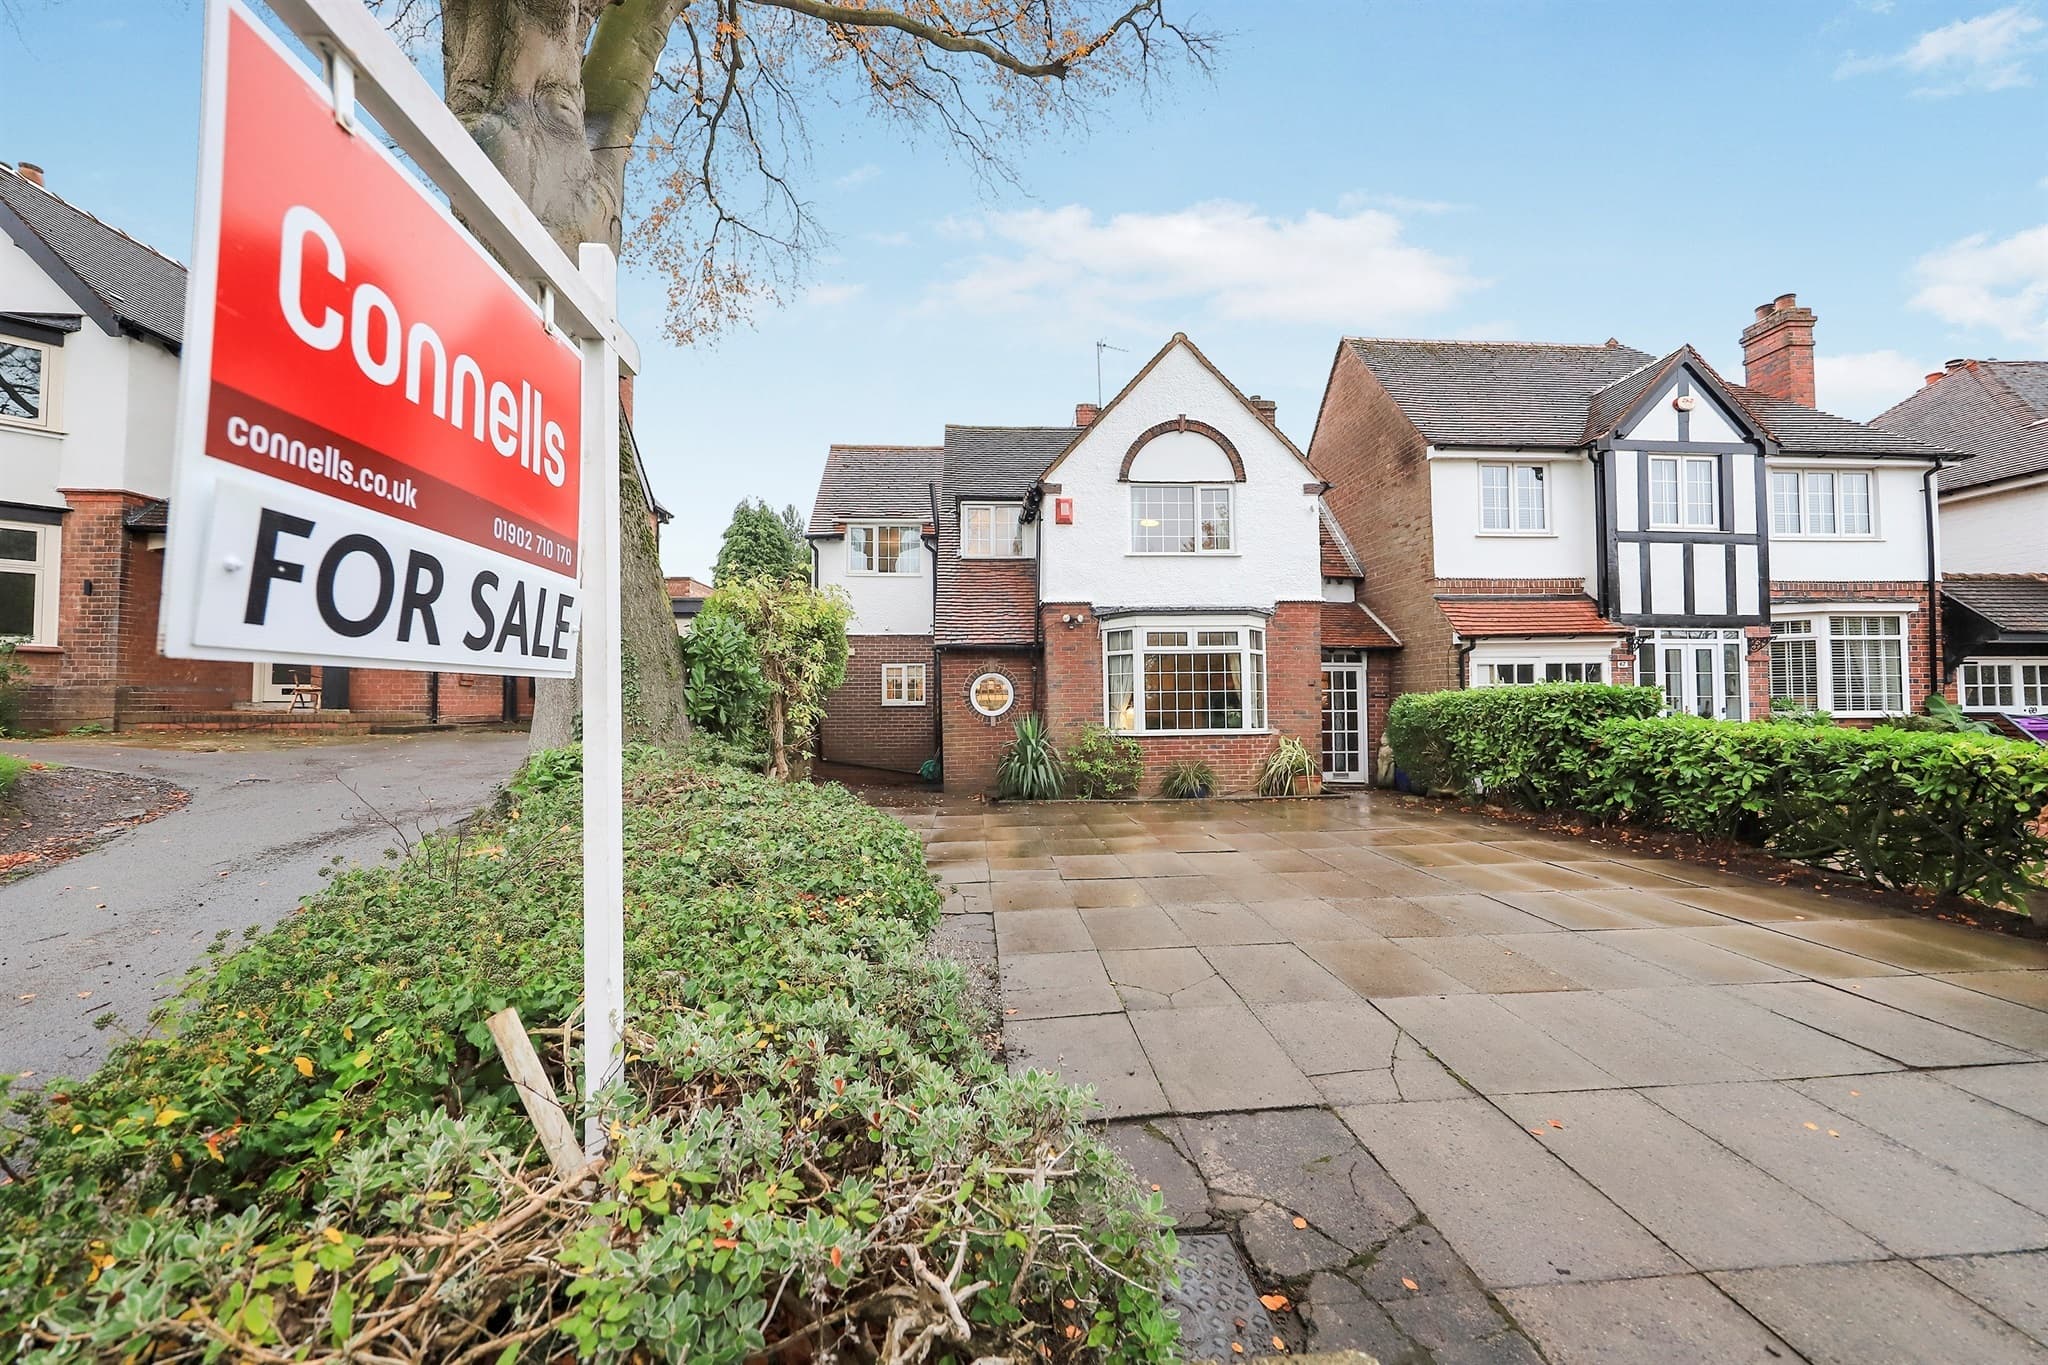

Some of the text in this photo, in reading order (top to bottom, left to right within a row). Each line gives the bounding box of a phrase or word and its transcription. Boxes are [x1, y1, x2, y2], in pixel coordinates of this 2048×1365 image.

[279, 206, 565, 488] Connells
[228, 416, 418, 509] connells.co.uk
[244, 508, 575, 660] FOR SALE
[493, 517, 573, 567] 01902 710 170
